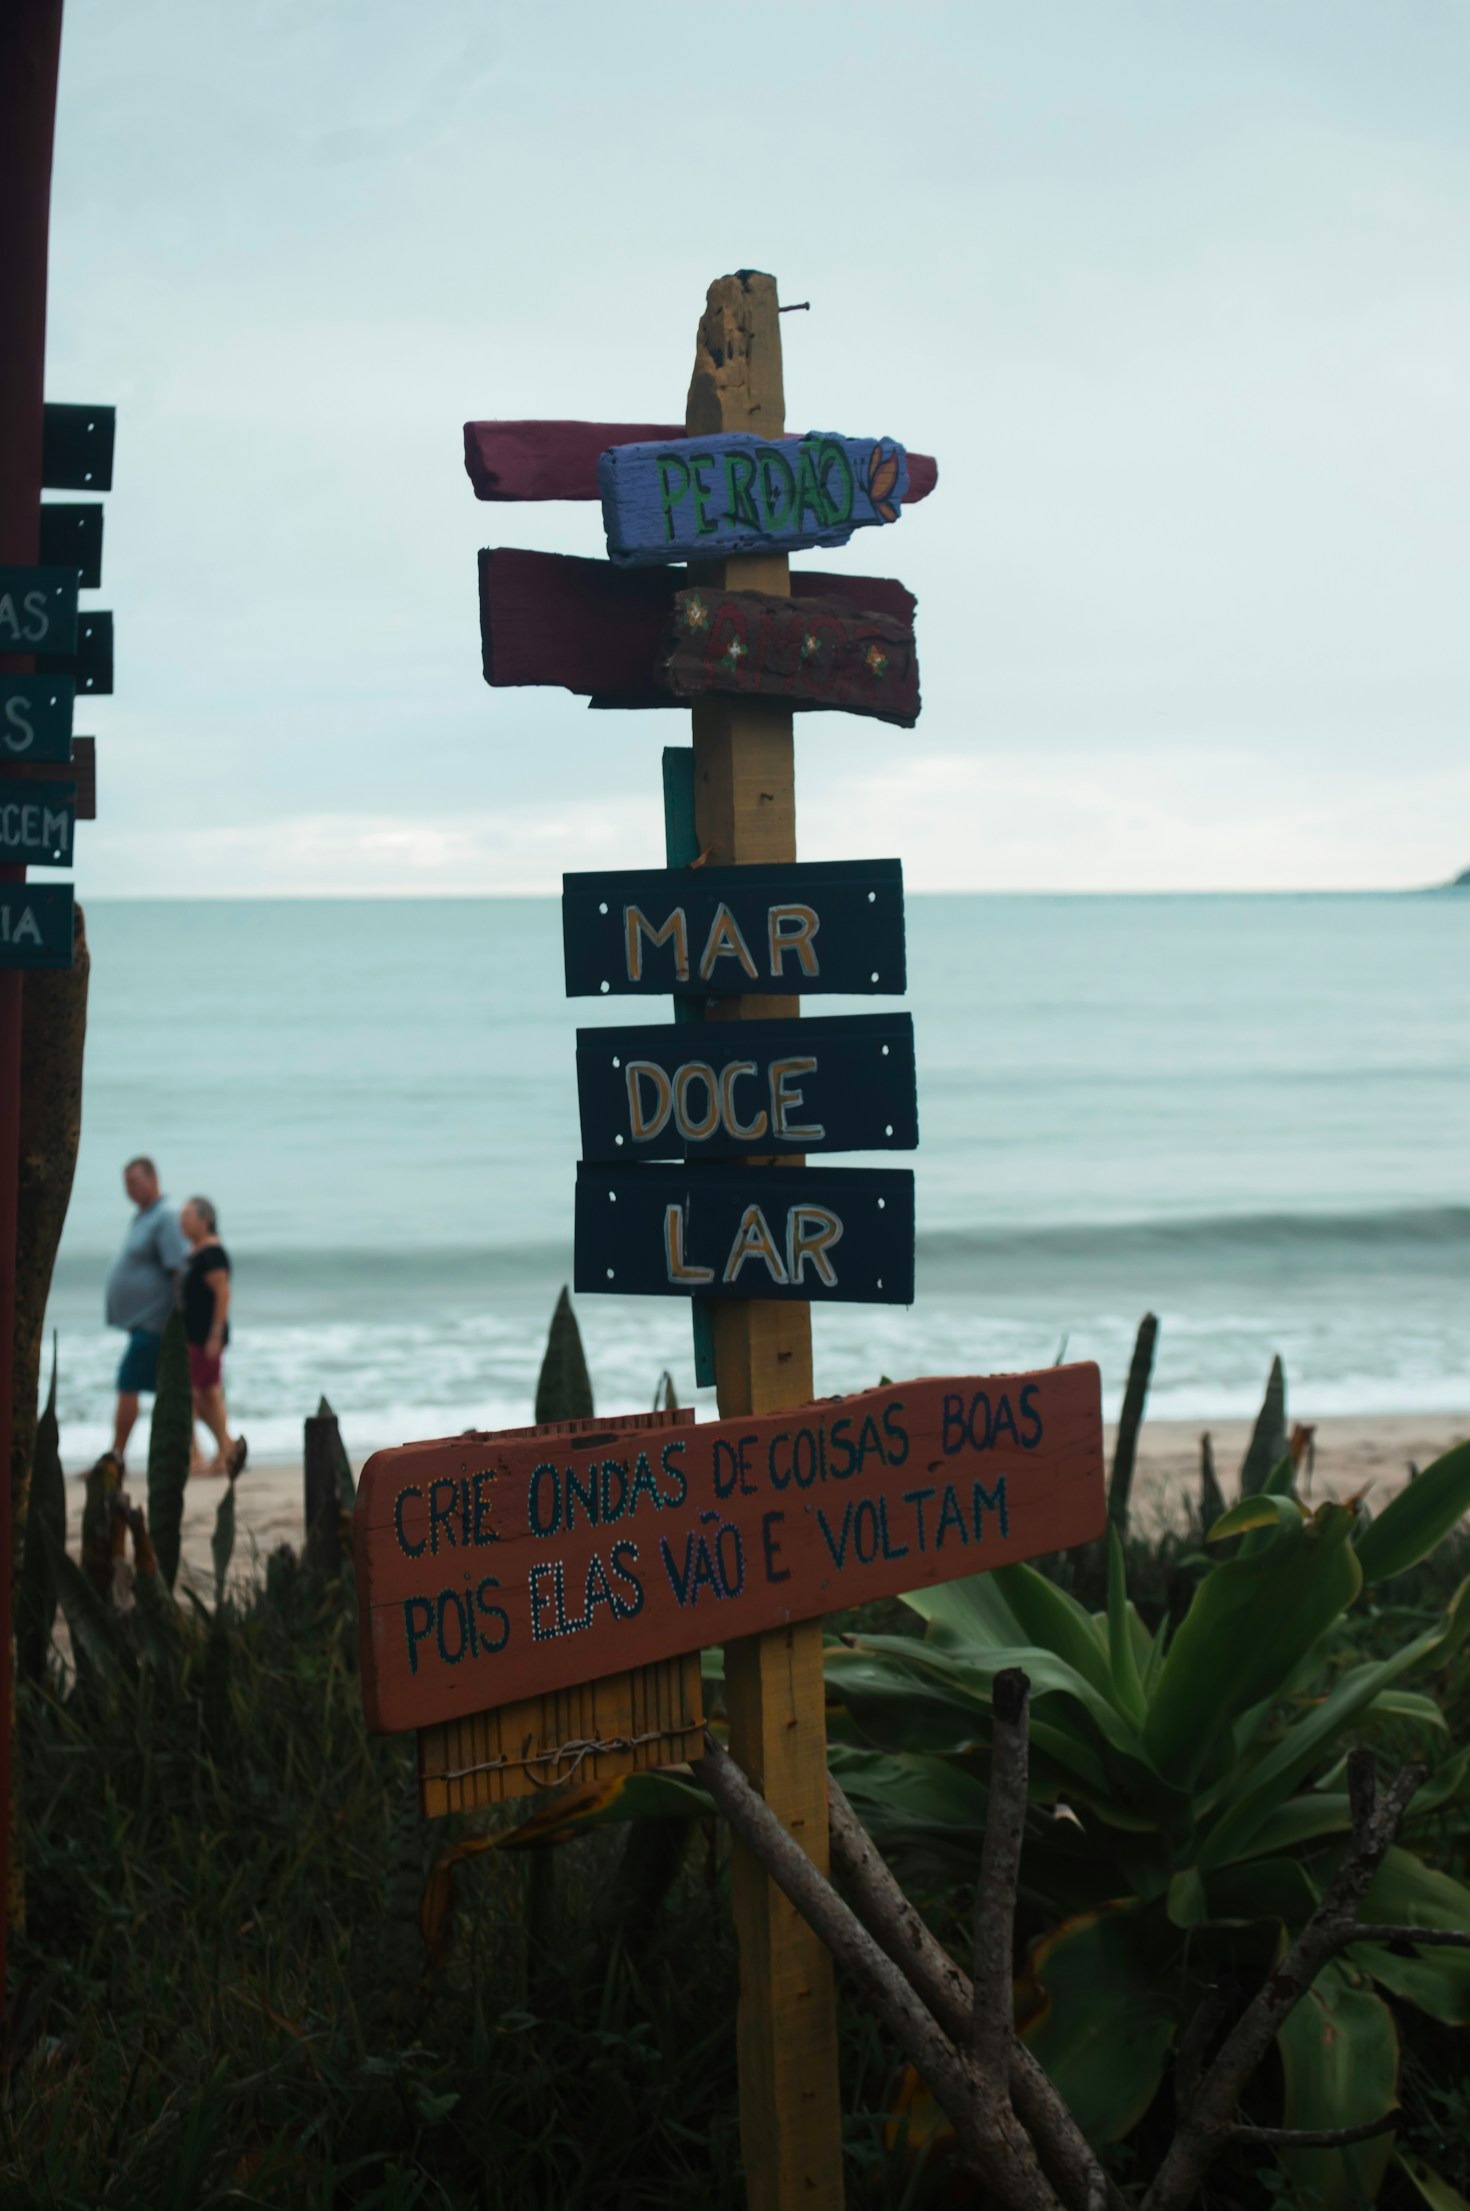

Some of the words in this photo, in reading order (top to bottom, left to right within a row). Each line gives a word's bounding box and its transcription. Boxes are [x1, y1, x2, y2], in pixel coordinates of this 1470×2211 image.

[0, 804, 68, 850] CEM
[624, 902, 820, 982] MAR
[626, 1057, 825, 1142] DOCE
[664, 1203, 844, 1287] LAR
[528, 1441, 688, 1538] ONDAS
[712, 1434, 759, 1499] DE
[942, 1384, 1044, 1456] BOAS
[528, 1539, 645, 1642] ELAS
[659, 1508, 744, 1608] VÃO
[762, 1511, 791, 1584] E
[816, 1474, 1010, 1571] VOLTAM
